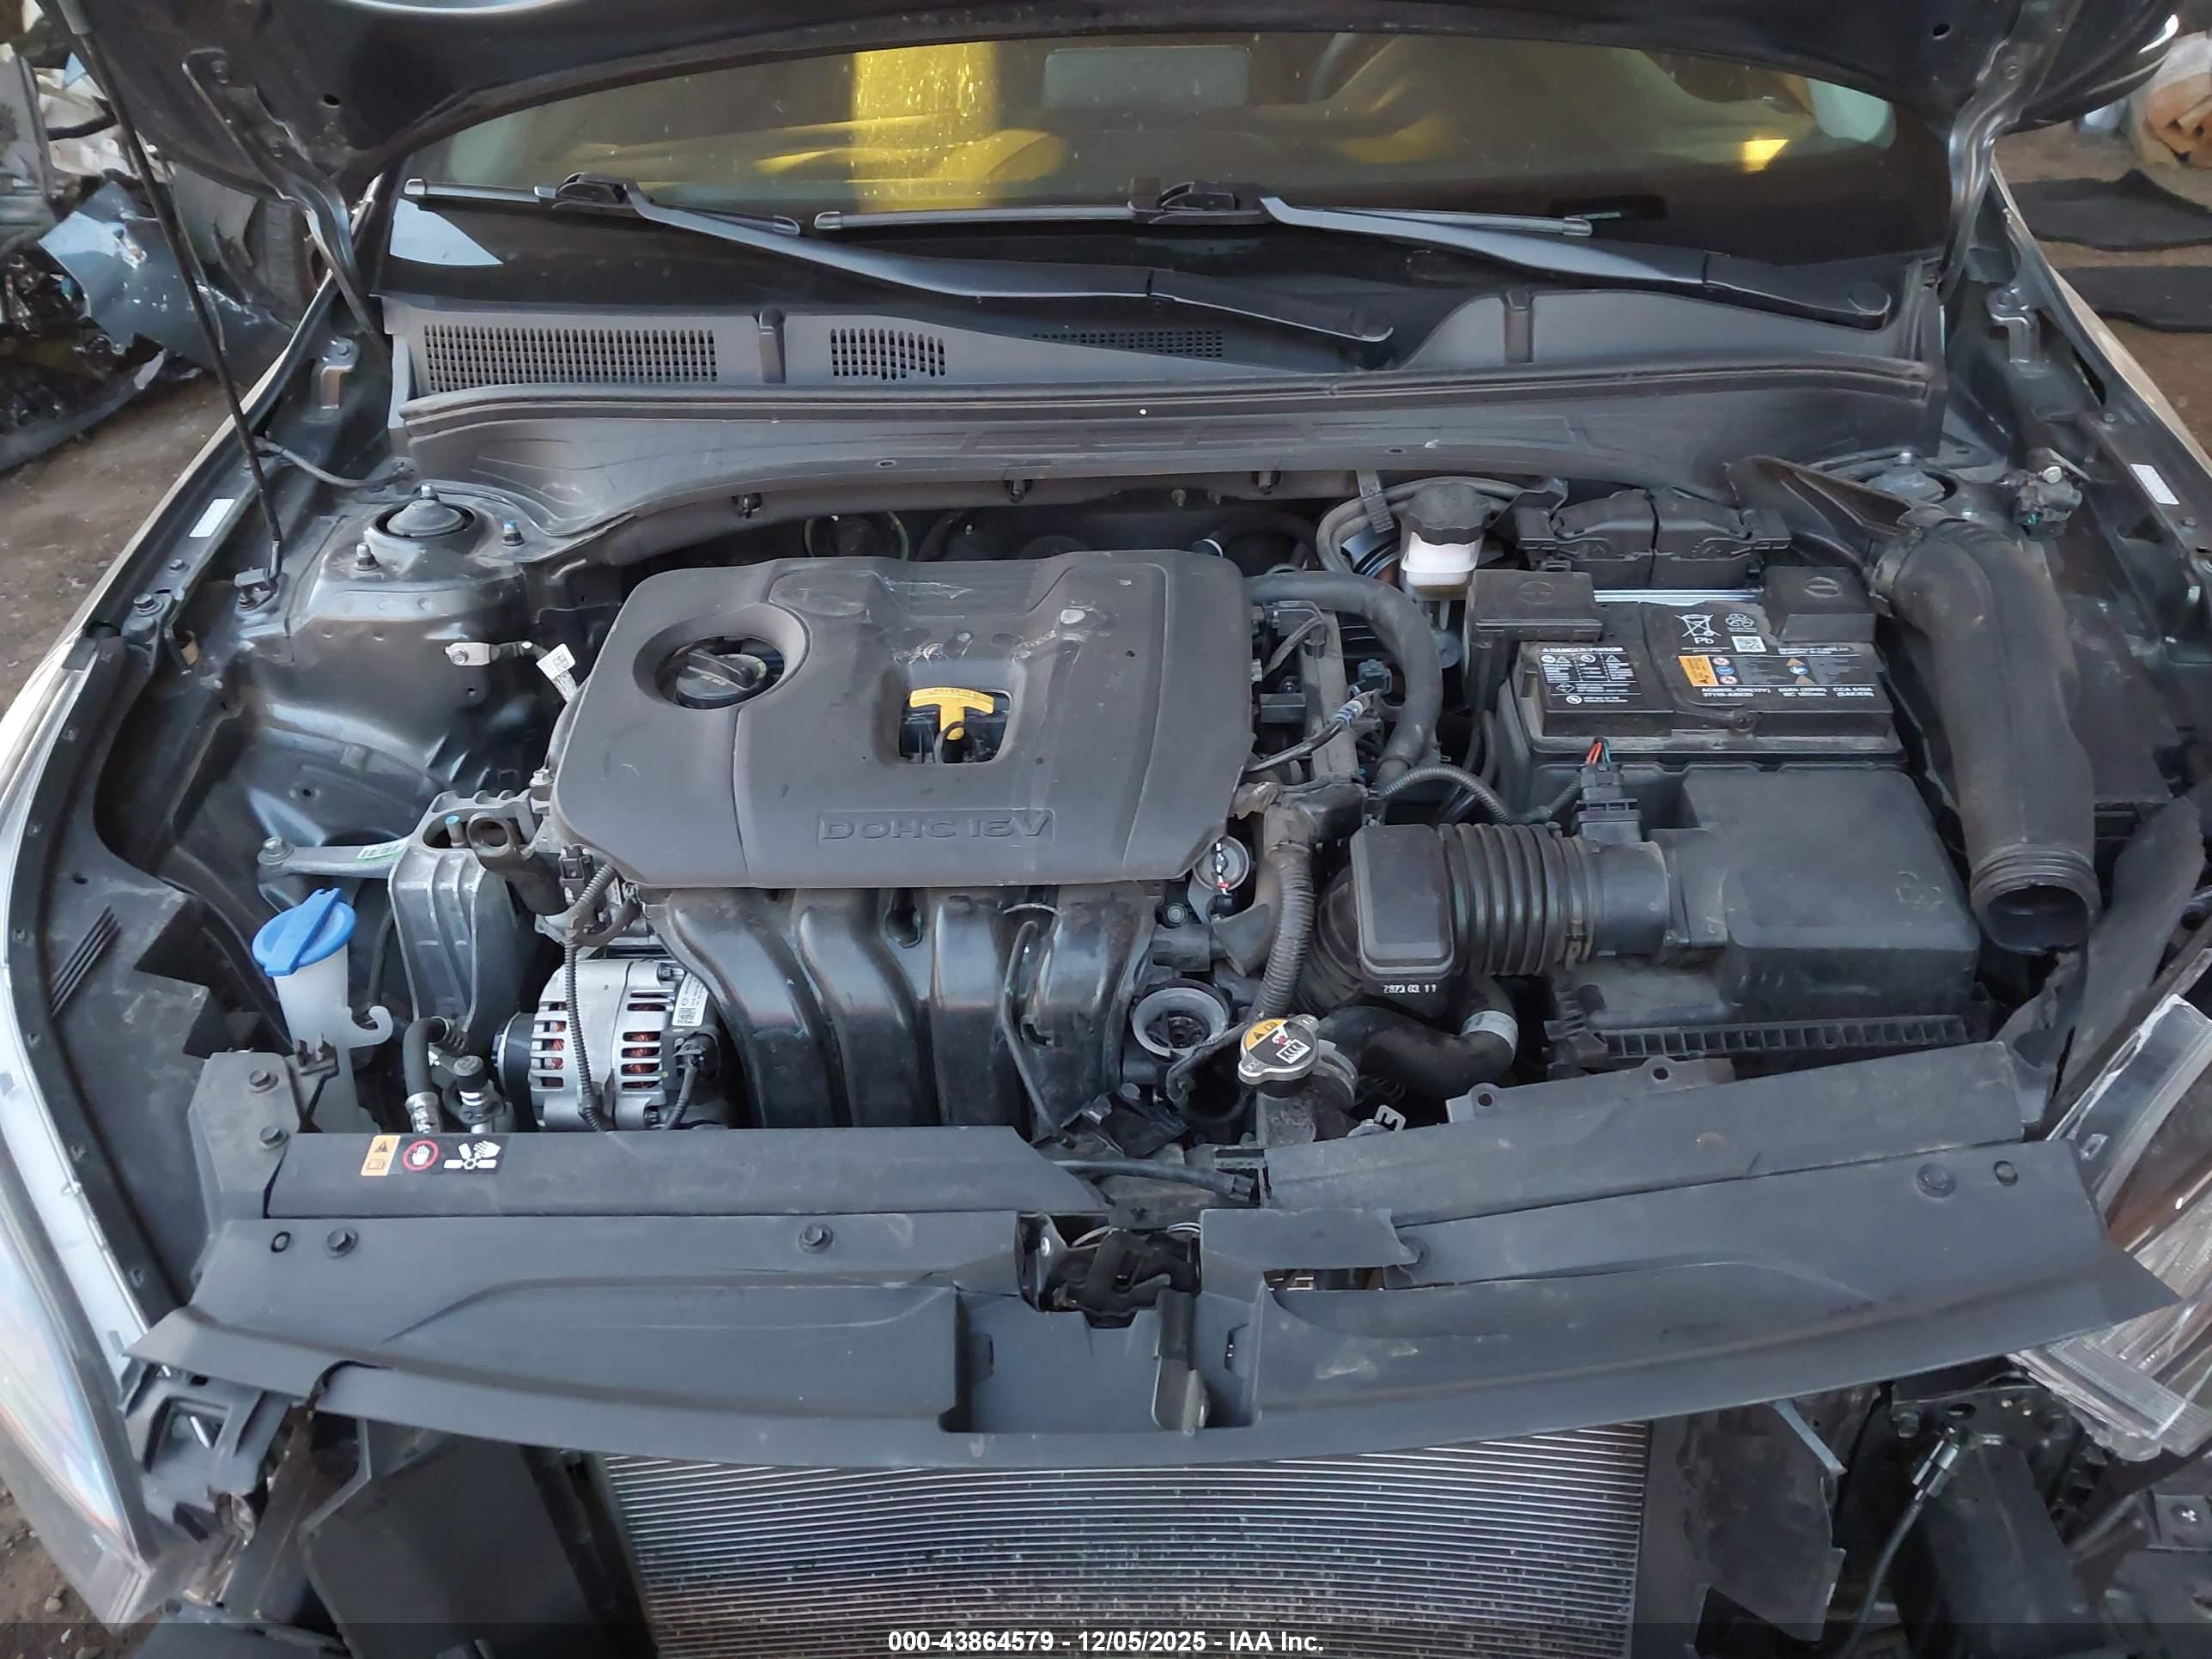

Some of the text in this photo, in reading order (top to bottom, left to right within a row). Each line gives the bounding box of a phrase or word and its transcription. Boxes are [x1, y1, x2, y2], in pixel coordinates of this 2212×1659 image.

[1693, 636, 1715, 645] Pb
[821, 814, 1050, 841] DOHC 16V
